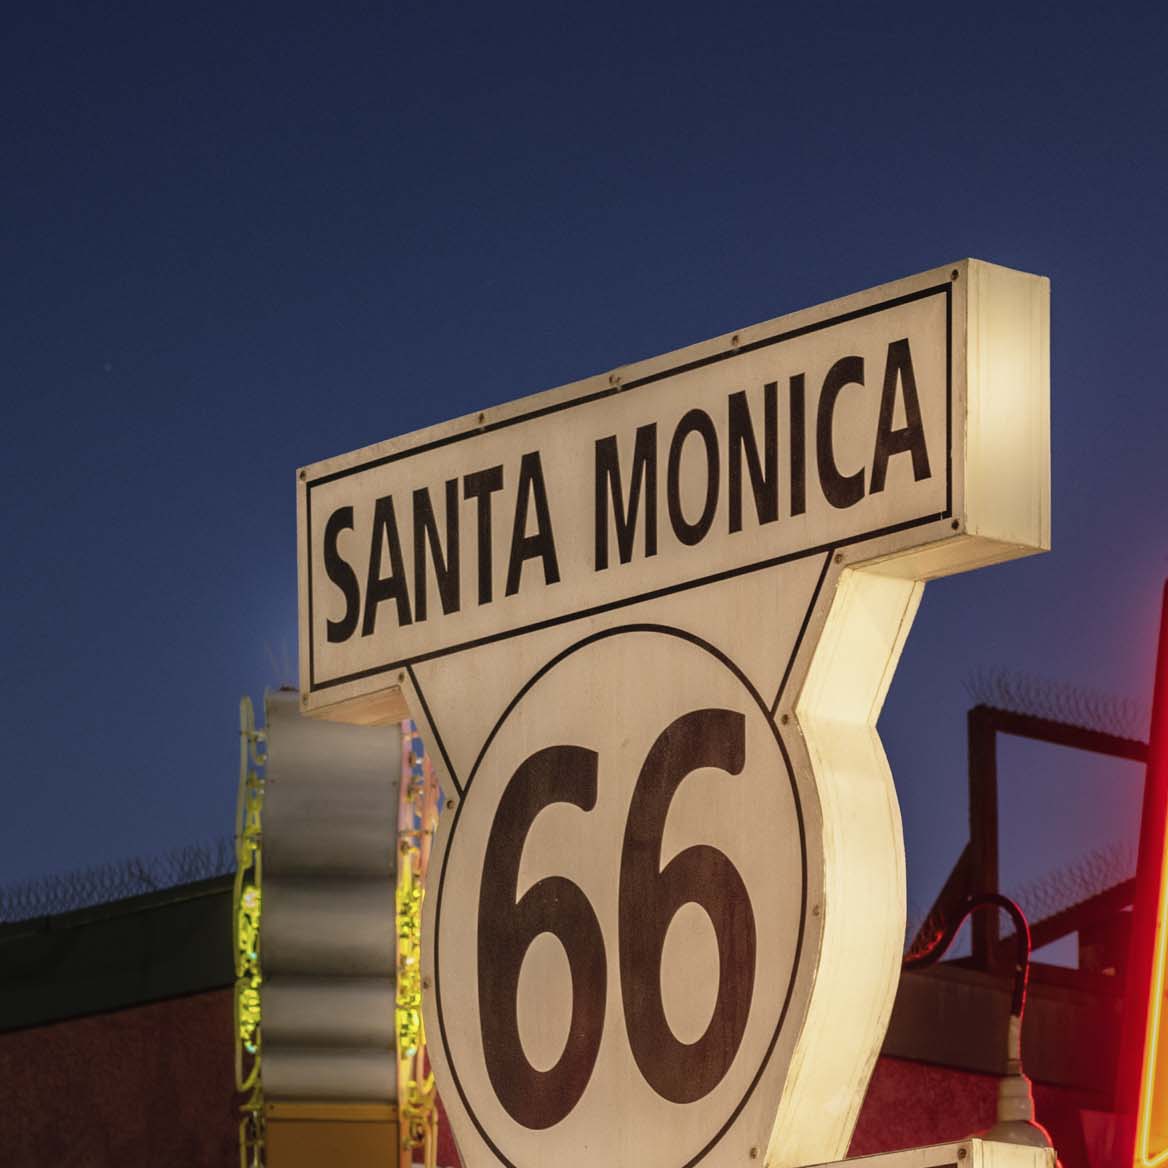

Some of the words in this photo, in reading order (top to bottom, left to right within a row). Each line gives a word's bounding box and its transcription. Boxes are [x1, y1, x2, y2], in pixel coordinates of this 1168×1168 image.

[324, 450, 561, 644] SANTA
[594, 338, 931, 572] MONICA
[477, 708, 757, 1130] 66
